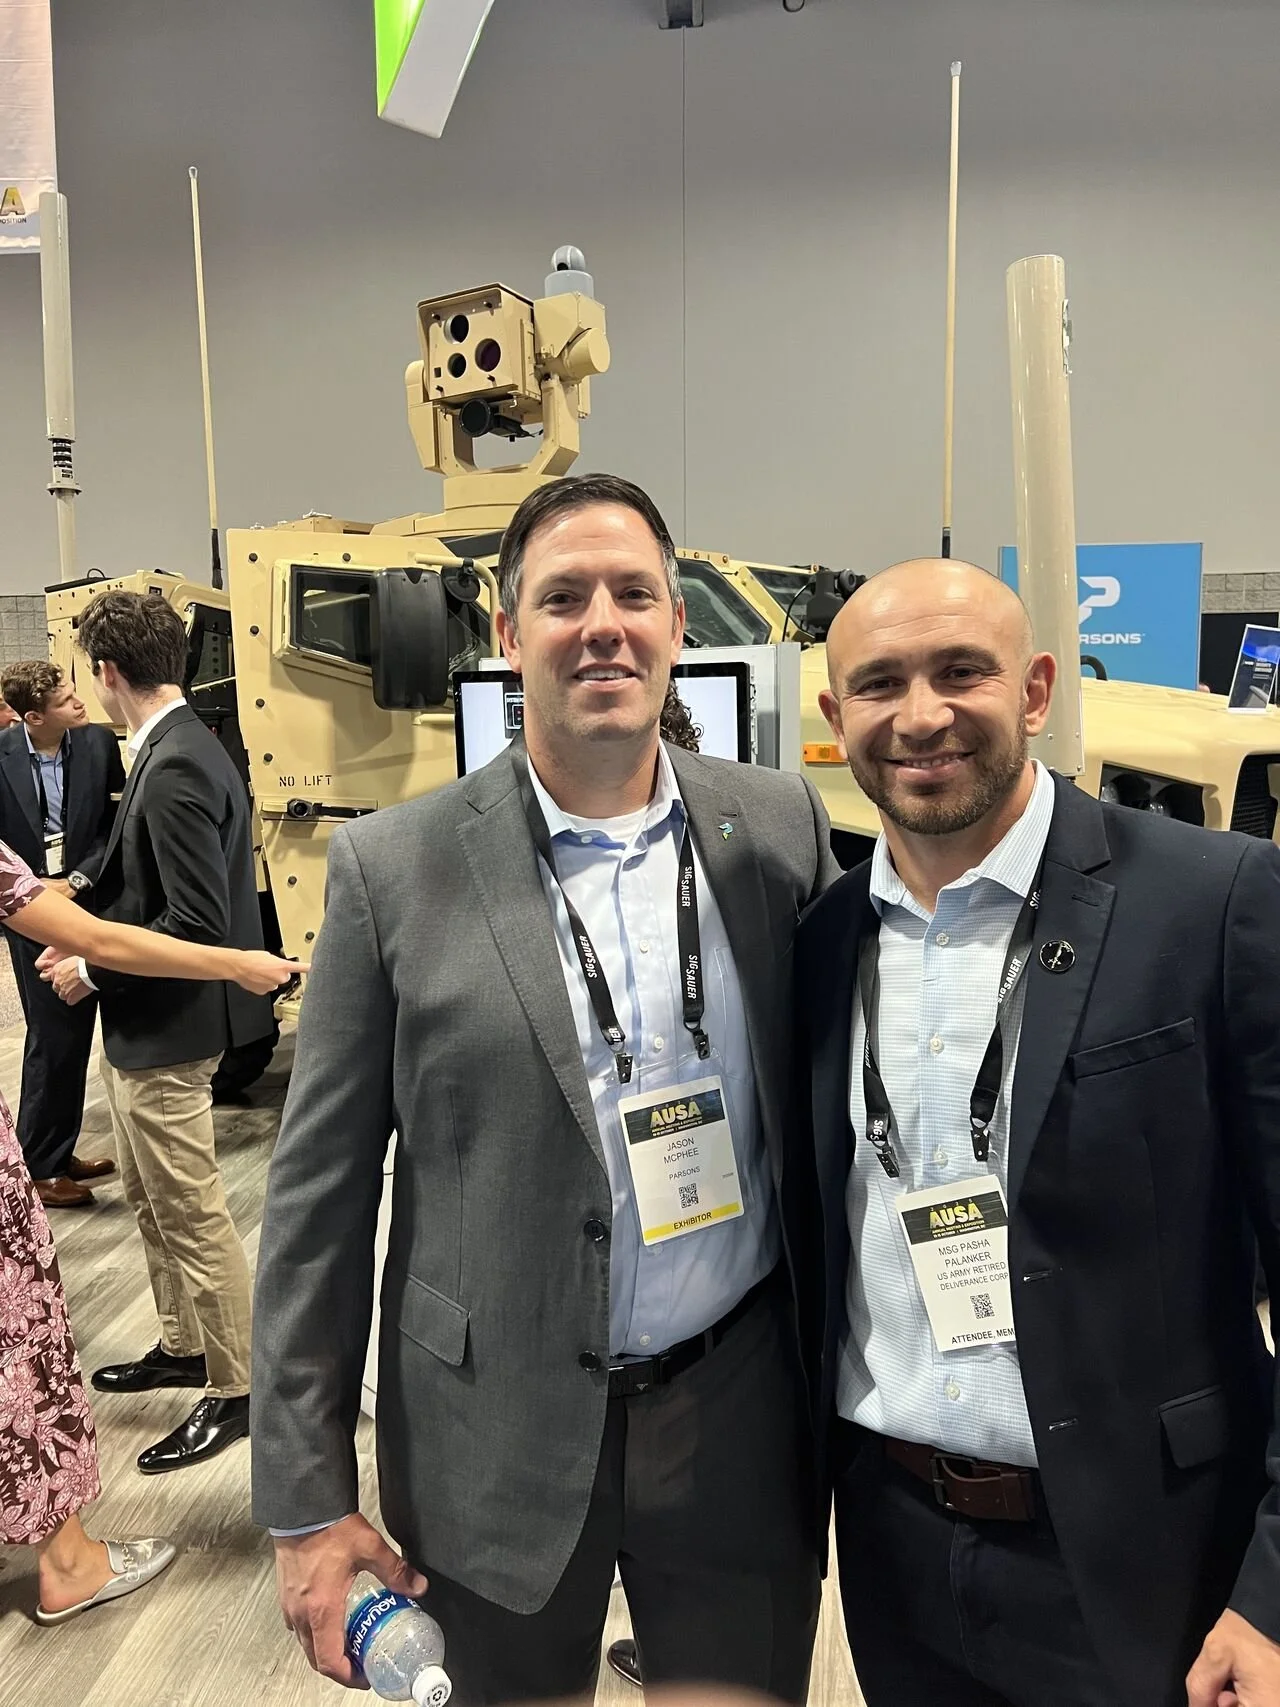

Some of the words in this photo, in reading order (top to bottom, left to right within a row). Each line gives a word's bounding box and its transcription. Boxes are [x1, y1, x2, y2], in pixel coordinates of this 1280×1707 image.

[279, 776, 295, 787] NO
[304, 774, 332, 786] LIFT
[650, 1101, 702, 1129] AUSA
[667, 1137, 695, 1152] JASON
[663, 1147, 699, 1164] MCPHEE
[669, 1166, 701, 1181] PARSONS
[673, 1211, 712, 1230] EXHIBITOR
[929, 1202, 984, 1229] AUSA
[938, 1244, 959, 1256] MSG
[959, 1238, 991, 1252] PASHA
[944, 1251, 992, 1268] PALANKER
[937, 1272, 949, 1281] US
[949, 1267, 971, 1279] ARMY
[972, 1261, 1007, 1274] RETIRED
[940, 1275, 989, 1291] DELIVERANCE
[989, 1271, 1009, 1283] CORP
[951, 1331, 995, 1344] ATTENDEE,
[351, 1595, 397, 1656] AQUAFINA
